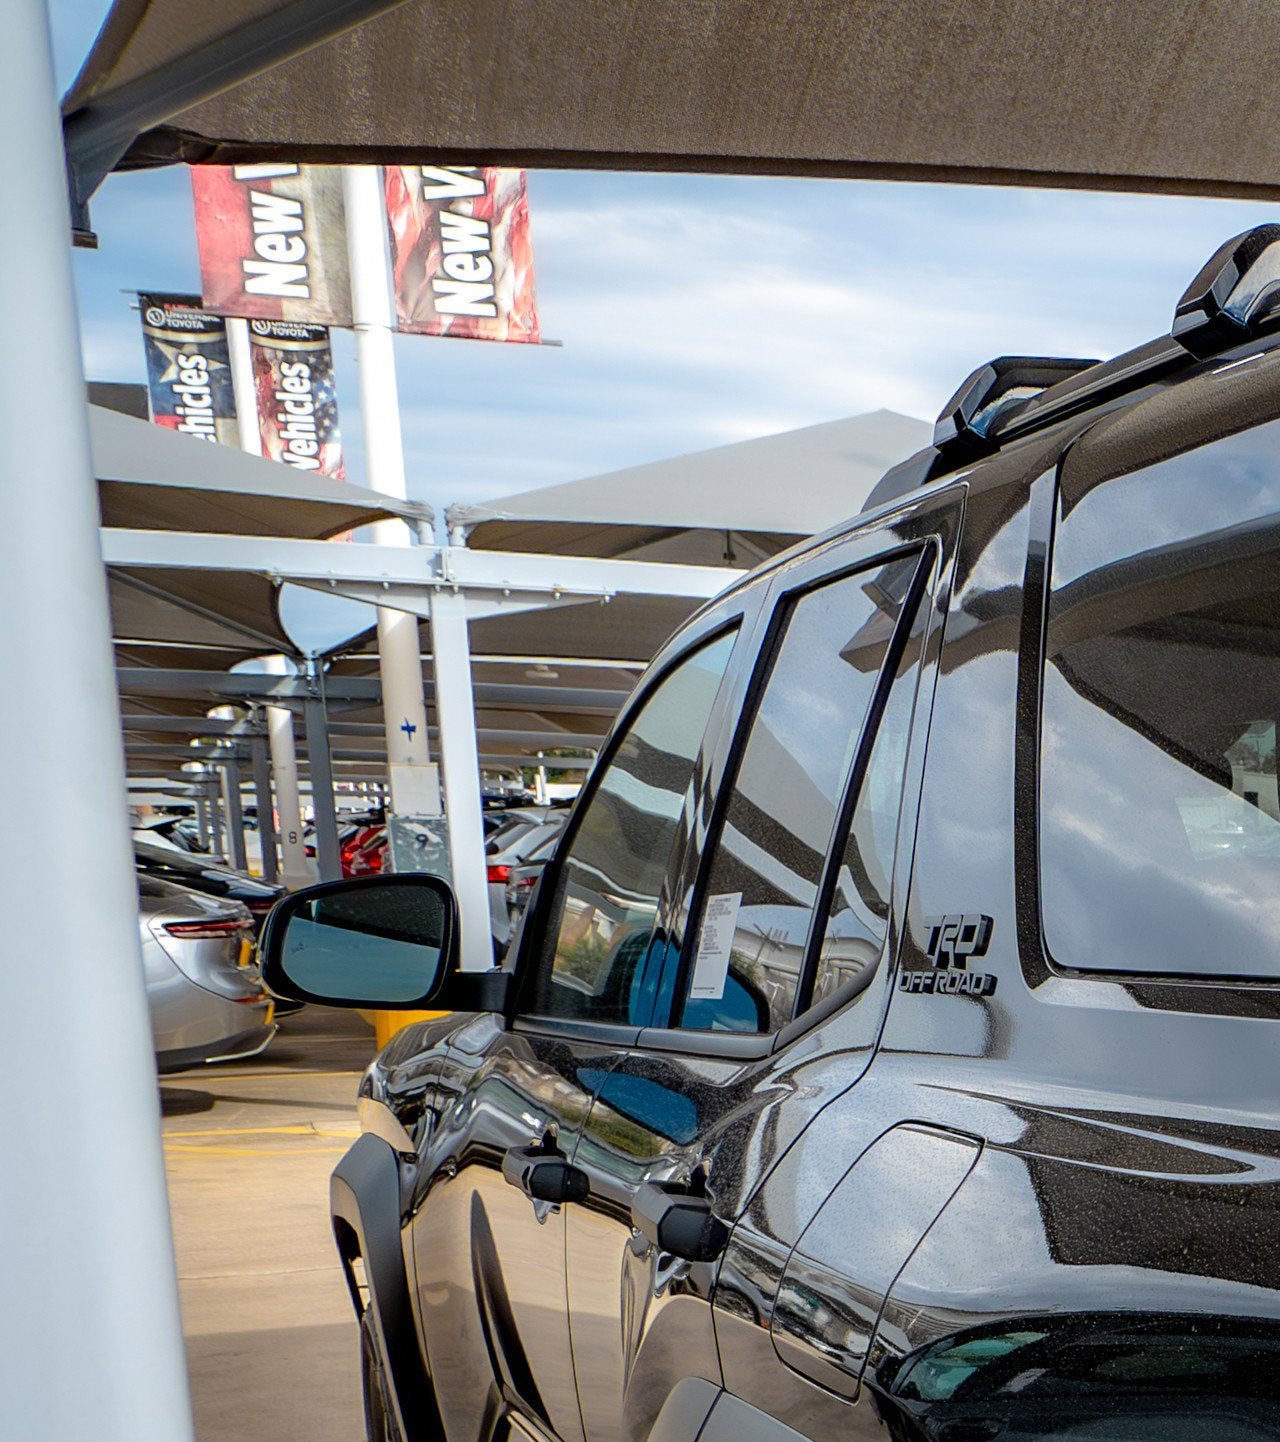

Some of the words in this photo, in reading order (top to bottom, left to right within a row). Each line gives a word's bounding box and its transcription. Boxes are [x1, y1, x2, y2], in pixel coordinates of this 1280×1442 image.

[243, 190, 311, 299] New
[432, 209, 498, 318] New
[167, 319, 205, 330] TOYOTA
[272, 327, 310, 338] TOYOTA
